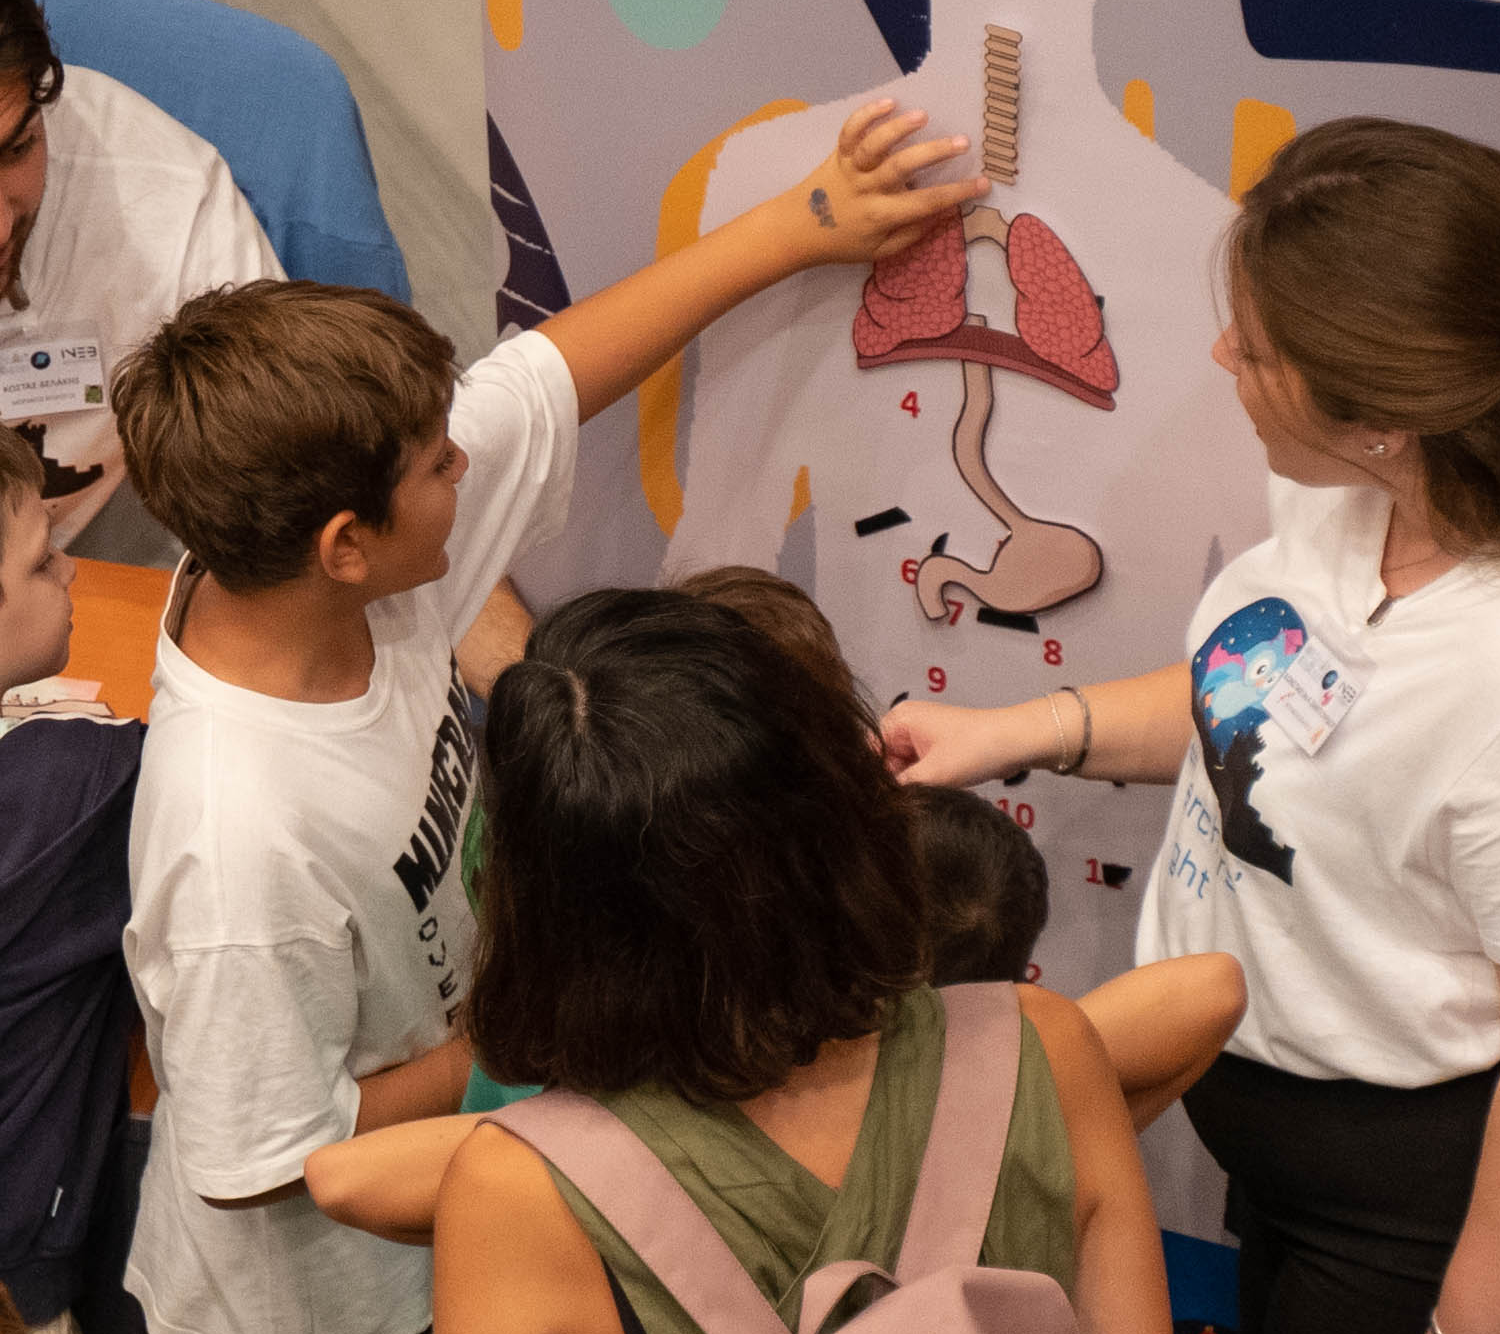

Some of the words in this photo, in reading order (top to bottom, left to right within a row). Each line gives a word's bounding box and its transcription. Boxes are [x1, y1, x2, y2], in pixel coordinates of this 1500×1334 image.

[900, 390, 921, 419] 4
[901, 559, 918, 586] 6
[945, 598, 965, 627] 7
[1042, 638, 1064, 666] 8
[927, 666, 947, 693] 9
